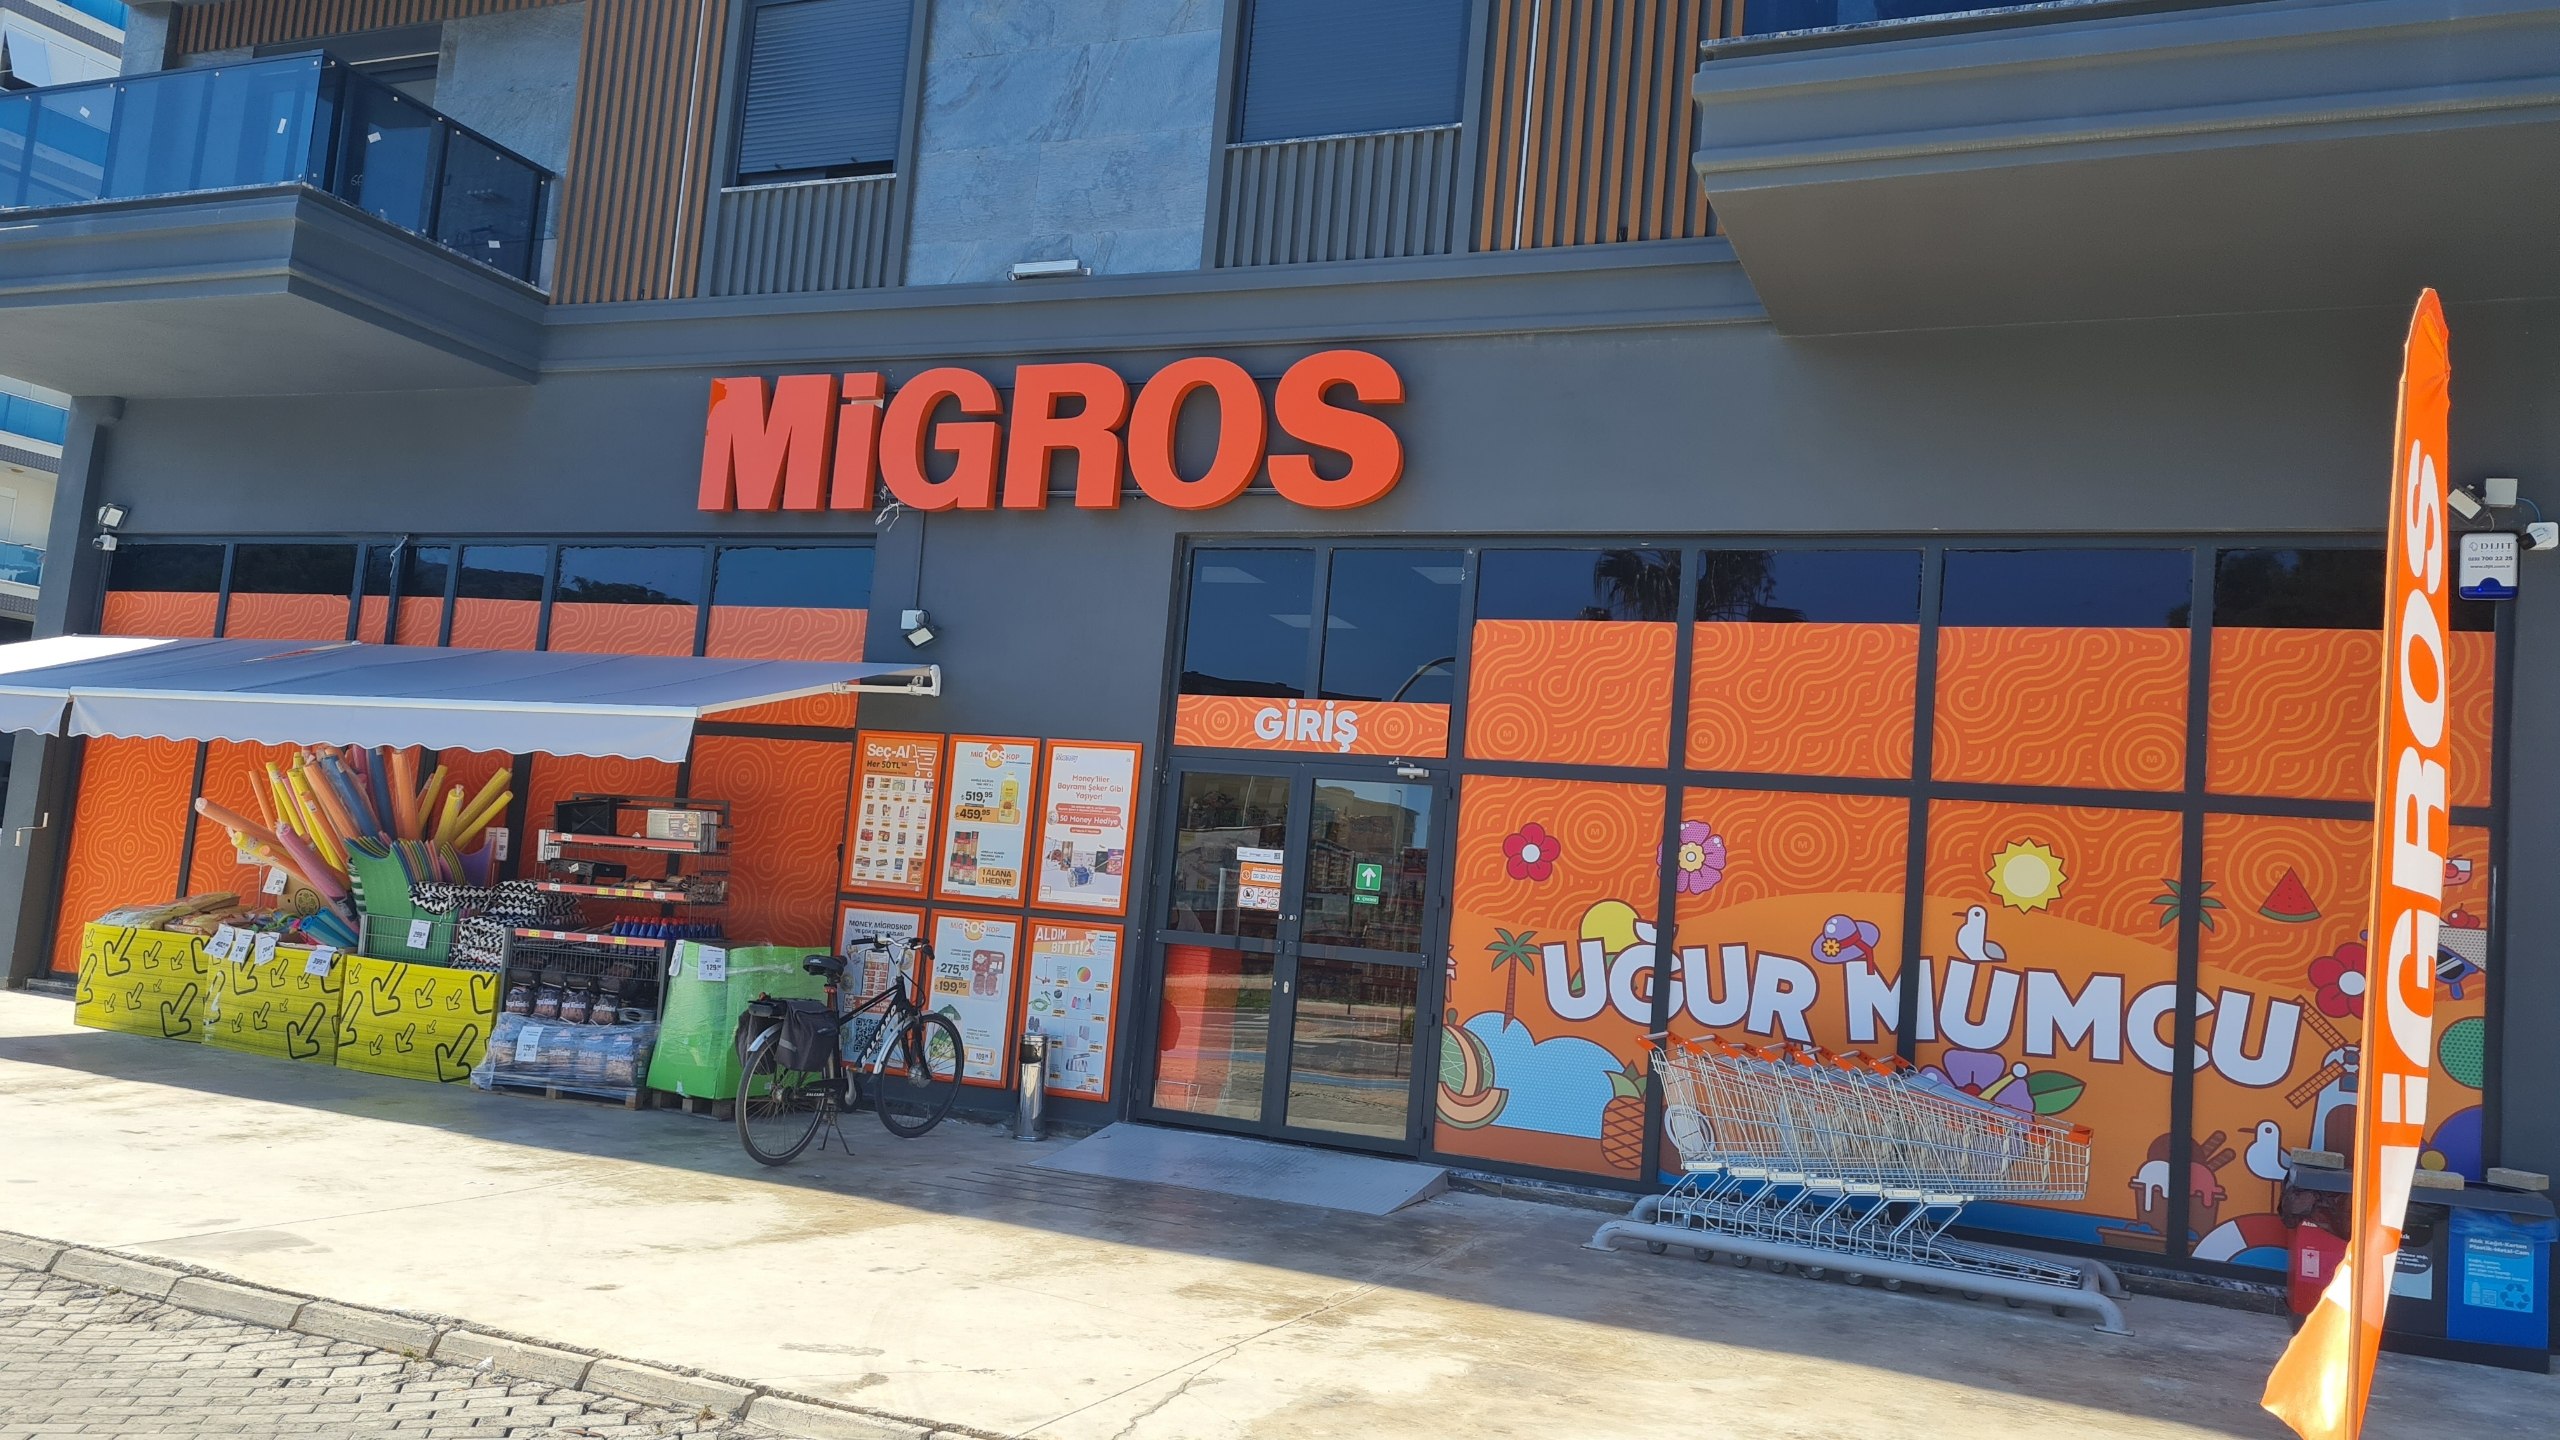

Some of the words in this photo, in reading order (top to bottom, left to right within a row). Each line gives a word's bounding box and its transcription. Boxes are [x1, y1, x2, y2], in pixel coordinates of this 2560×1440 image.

[1254, 699, 1359, 753] GİRİŞ
[866, 743, 911, 761] Seç-Al
[866, 760, 881, 768] Her
[1088, 784, 1108, 792] Şeker
[1070, 815, 1093, 825] Money
[986, 870, 1012, 878] ALANA
[1035, 927, 1067, 941] ALDIM
[1843, 955, 2305, 1090] MUMCU
[2469, 1243, 2530, 1256] Plastik-Metal-Cam
